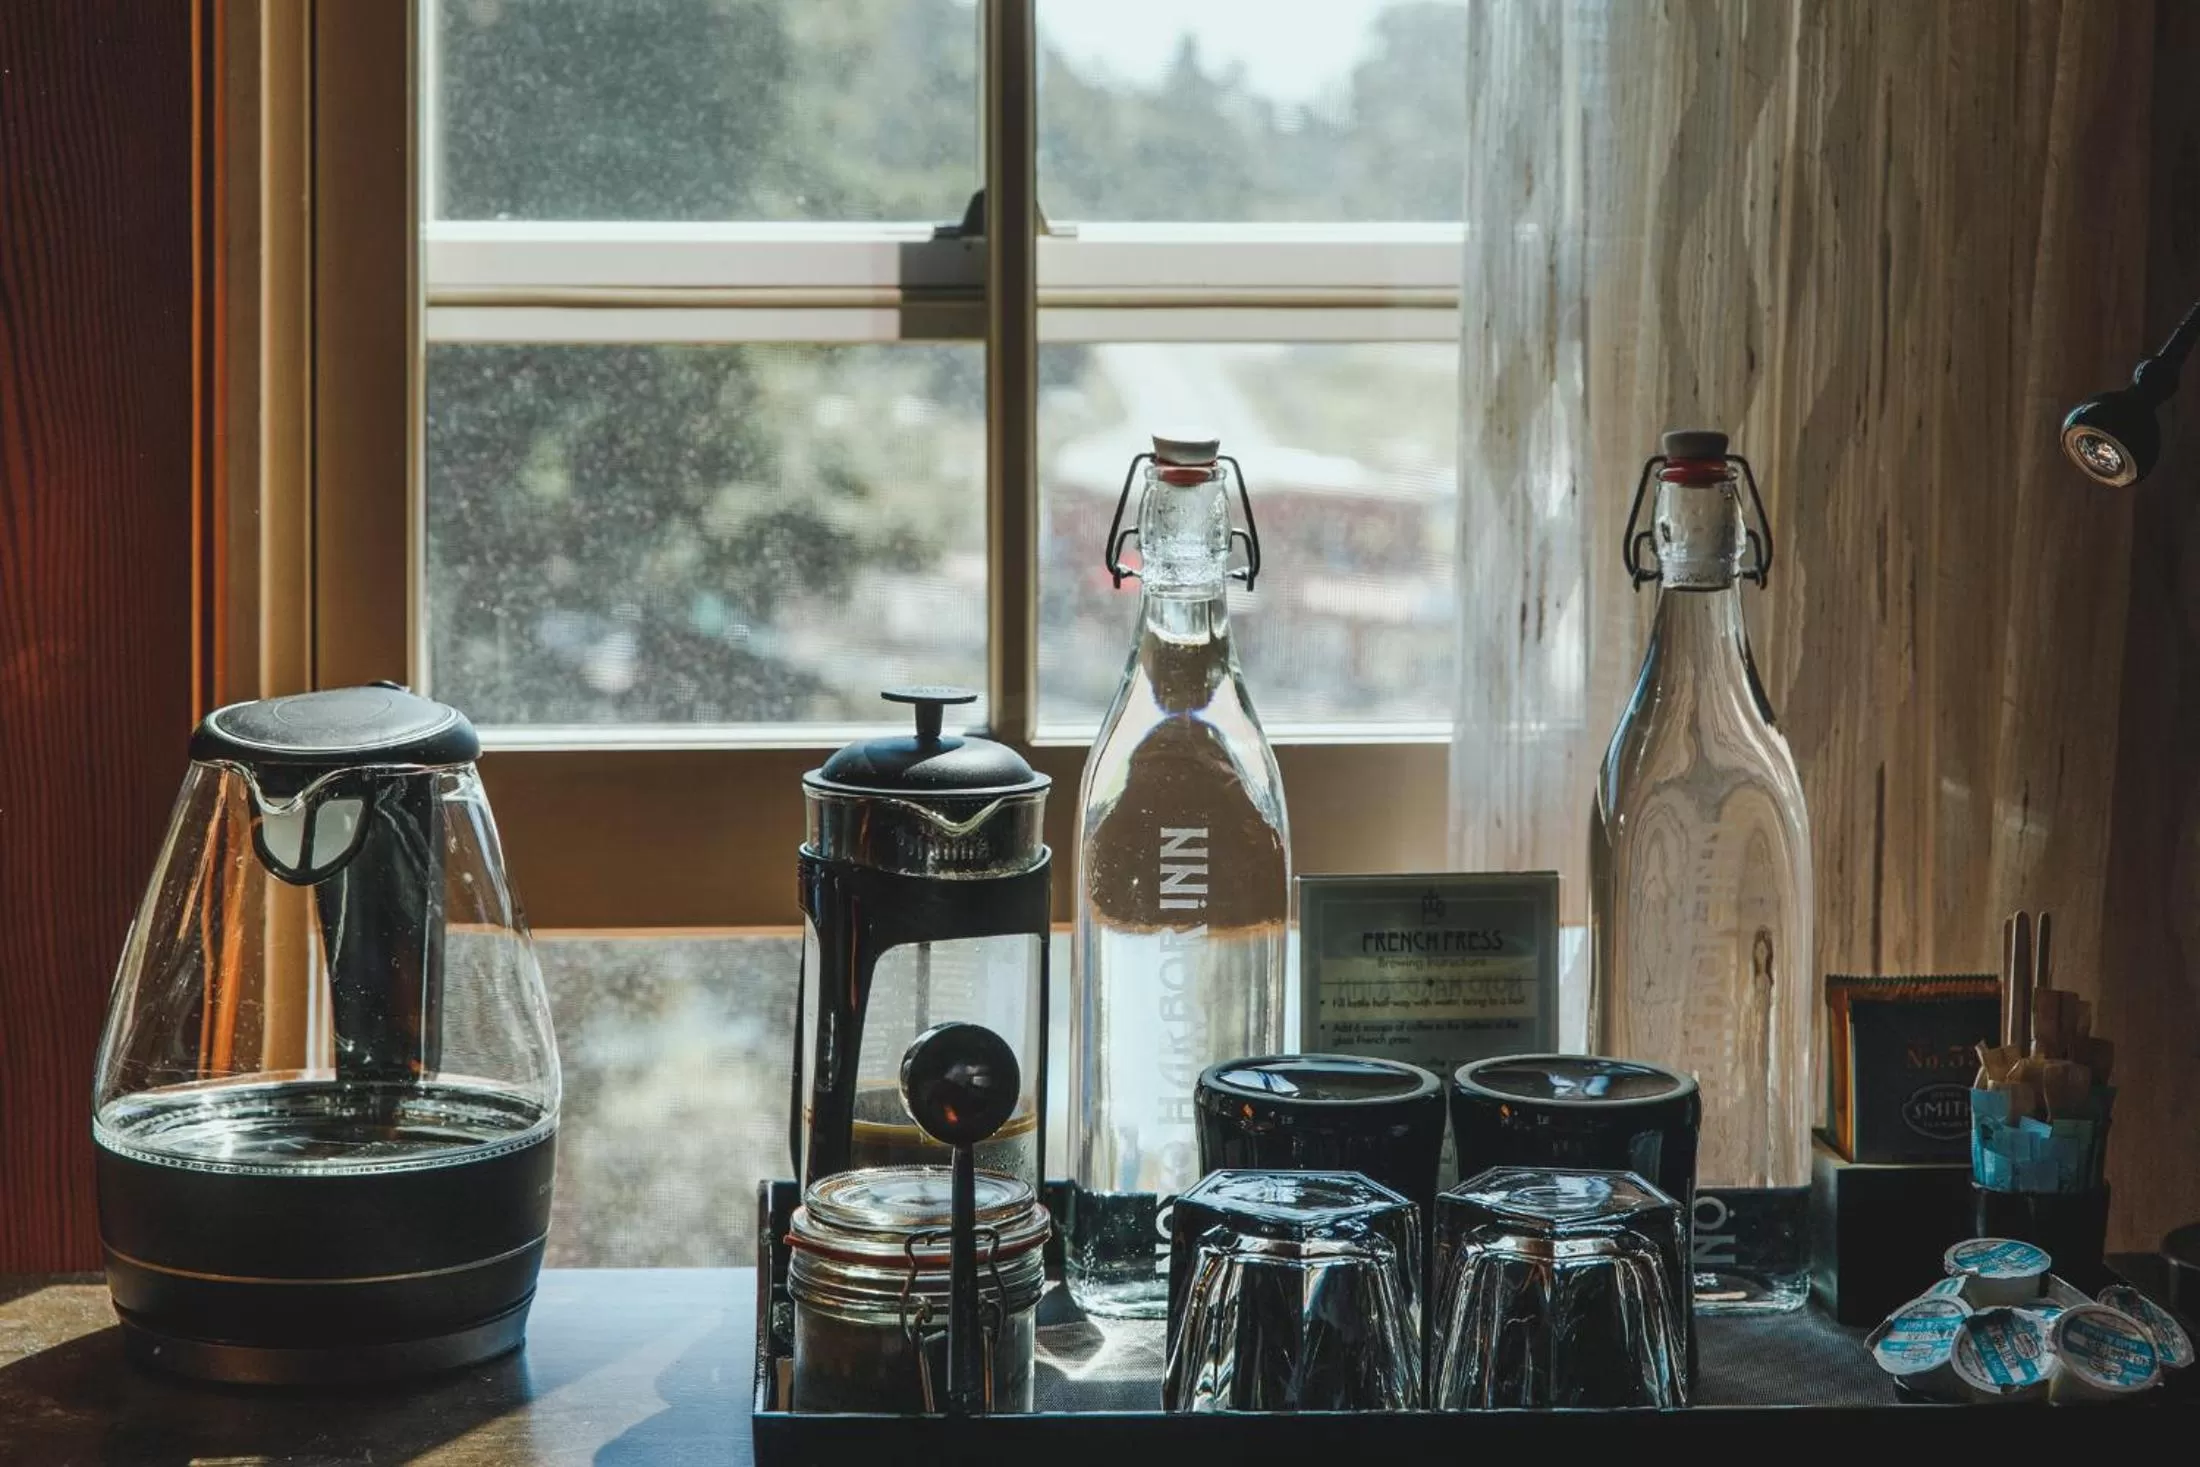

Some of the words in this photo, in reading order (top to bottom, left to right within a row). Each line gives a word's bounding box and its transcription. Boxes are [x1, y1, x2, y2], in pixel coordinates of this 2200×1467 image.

[1159, 826, 1209, 910] INN
[1362, 931, 1438, 952] FRENCH
[1443, 930, 1505, 951] PRESS
[1378, 956, 1423, 970] Brewing
[1158, 924, 1207, 1125] HARBOR
